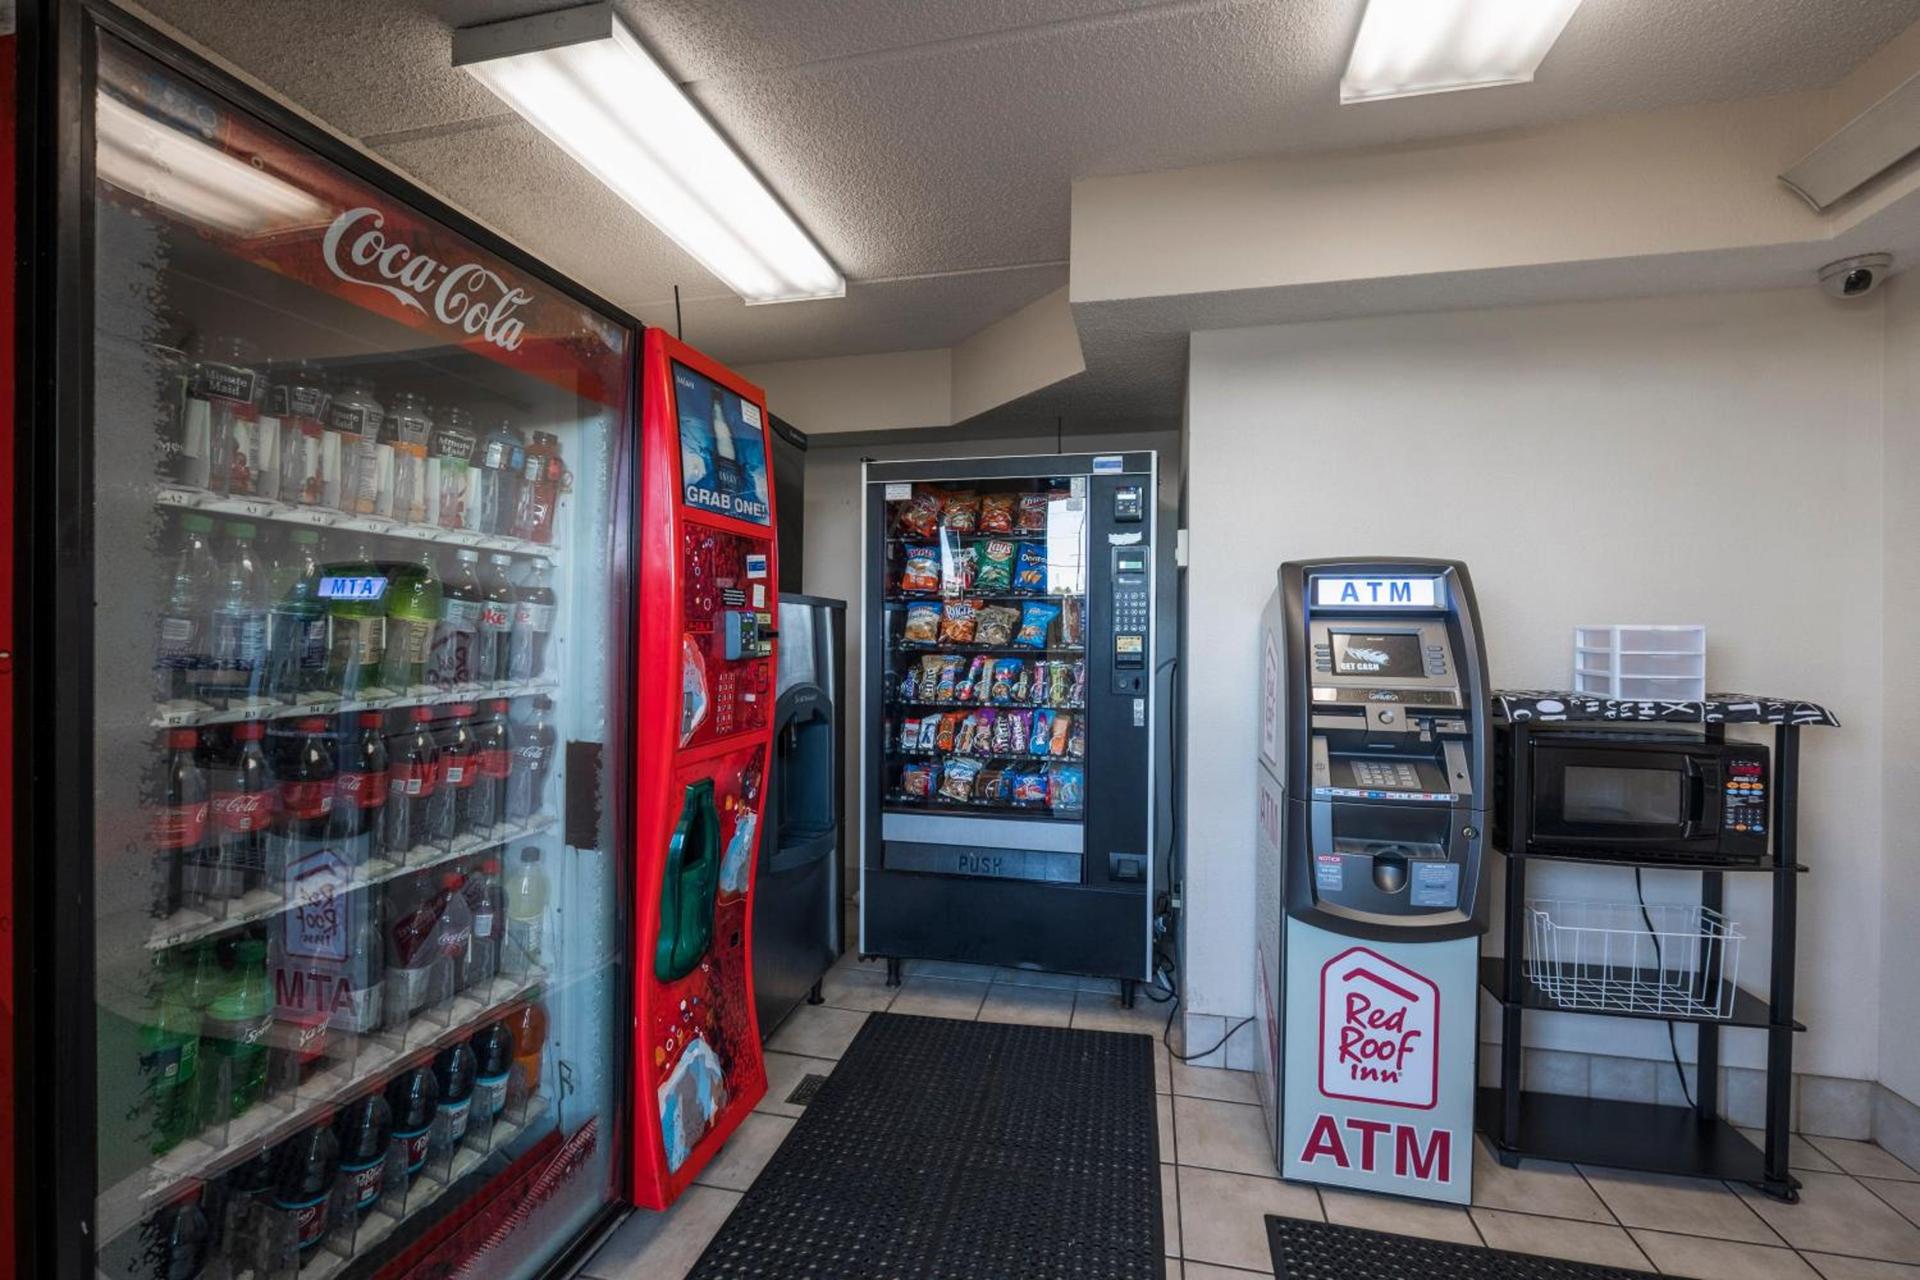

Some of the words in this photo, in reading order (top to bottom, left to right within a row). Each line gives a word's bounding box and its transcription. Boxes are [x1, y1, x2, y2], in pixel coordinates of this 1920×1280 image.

[323, 207, 536, 352] Coca-Cola
[686, 485, 731, 509] GRAB
[734, 498, 767, 517] ONE!
[1340, 582, 1412, 603] ATM
[1341, 662, 1356, 670] GET
[1357, 662, 1379, 671] CASH
[958, 855, 1003, 873] PUSH
[1346, 992, 1407, 1034] Red
[1339, 1026, 1421, 1070] Roof
[1351, 1062, 1399, 1083] inn
[1300, 1114, 1451, 1183] ATM
